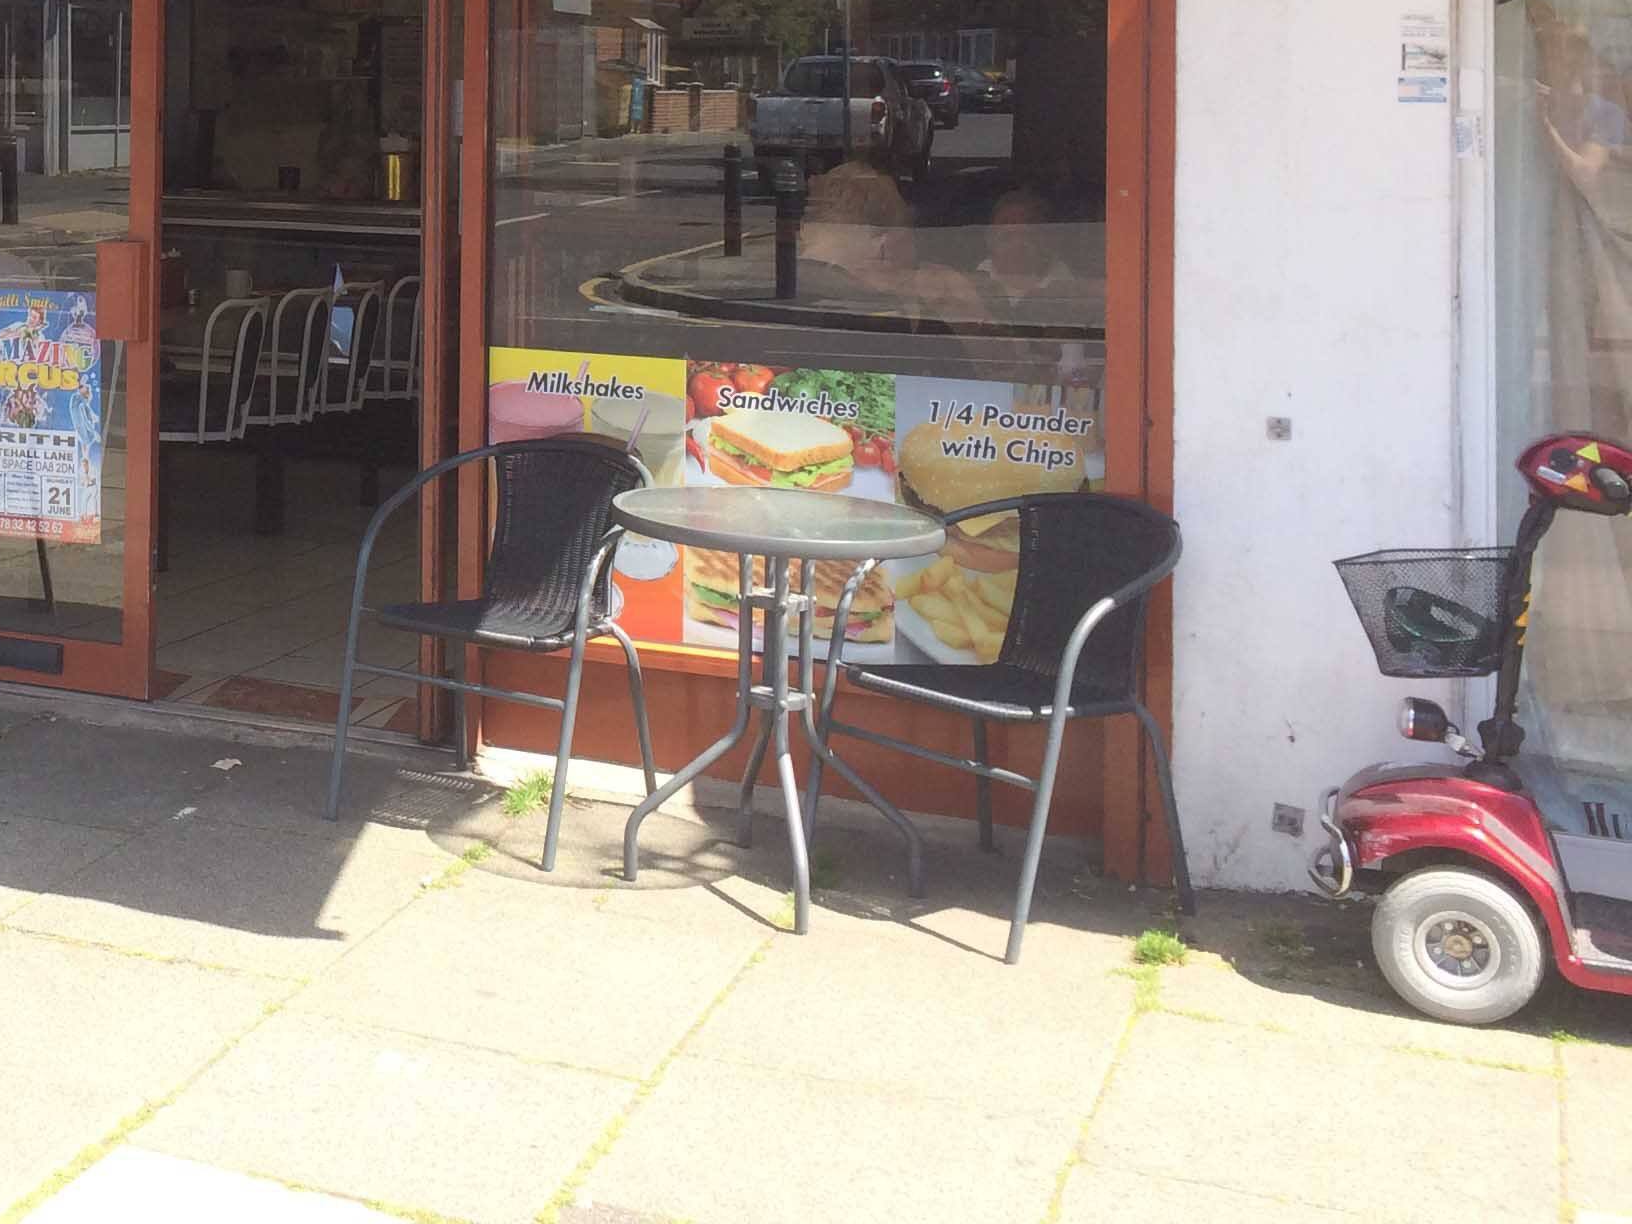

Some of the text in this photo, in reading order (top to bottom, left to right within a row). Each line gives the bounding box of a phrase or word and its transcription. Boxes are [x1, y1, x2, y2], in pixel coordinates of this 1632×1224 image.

[525, 370, 645, 401] Milkshakes
[717, 386, 860, 419] Sandwiches
[927, 399, 1093, 436] 1/4 Pounder
[2, 459, 33, 471] SPACE
[44, 450, 74, 462] LANE
[941, 435, 1075, 470] with Chips
[48, 487, 71, 506] 21
[47, 505, 72, 516] JUNE
